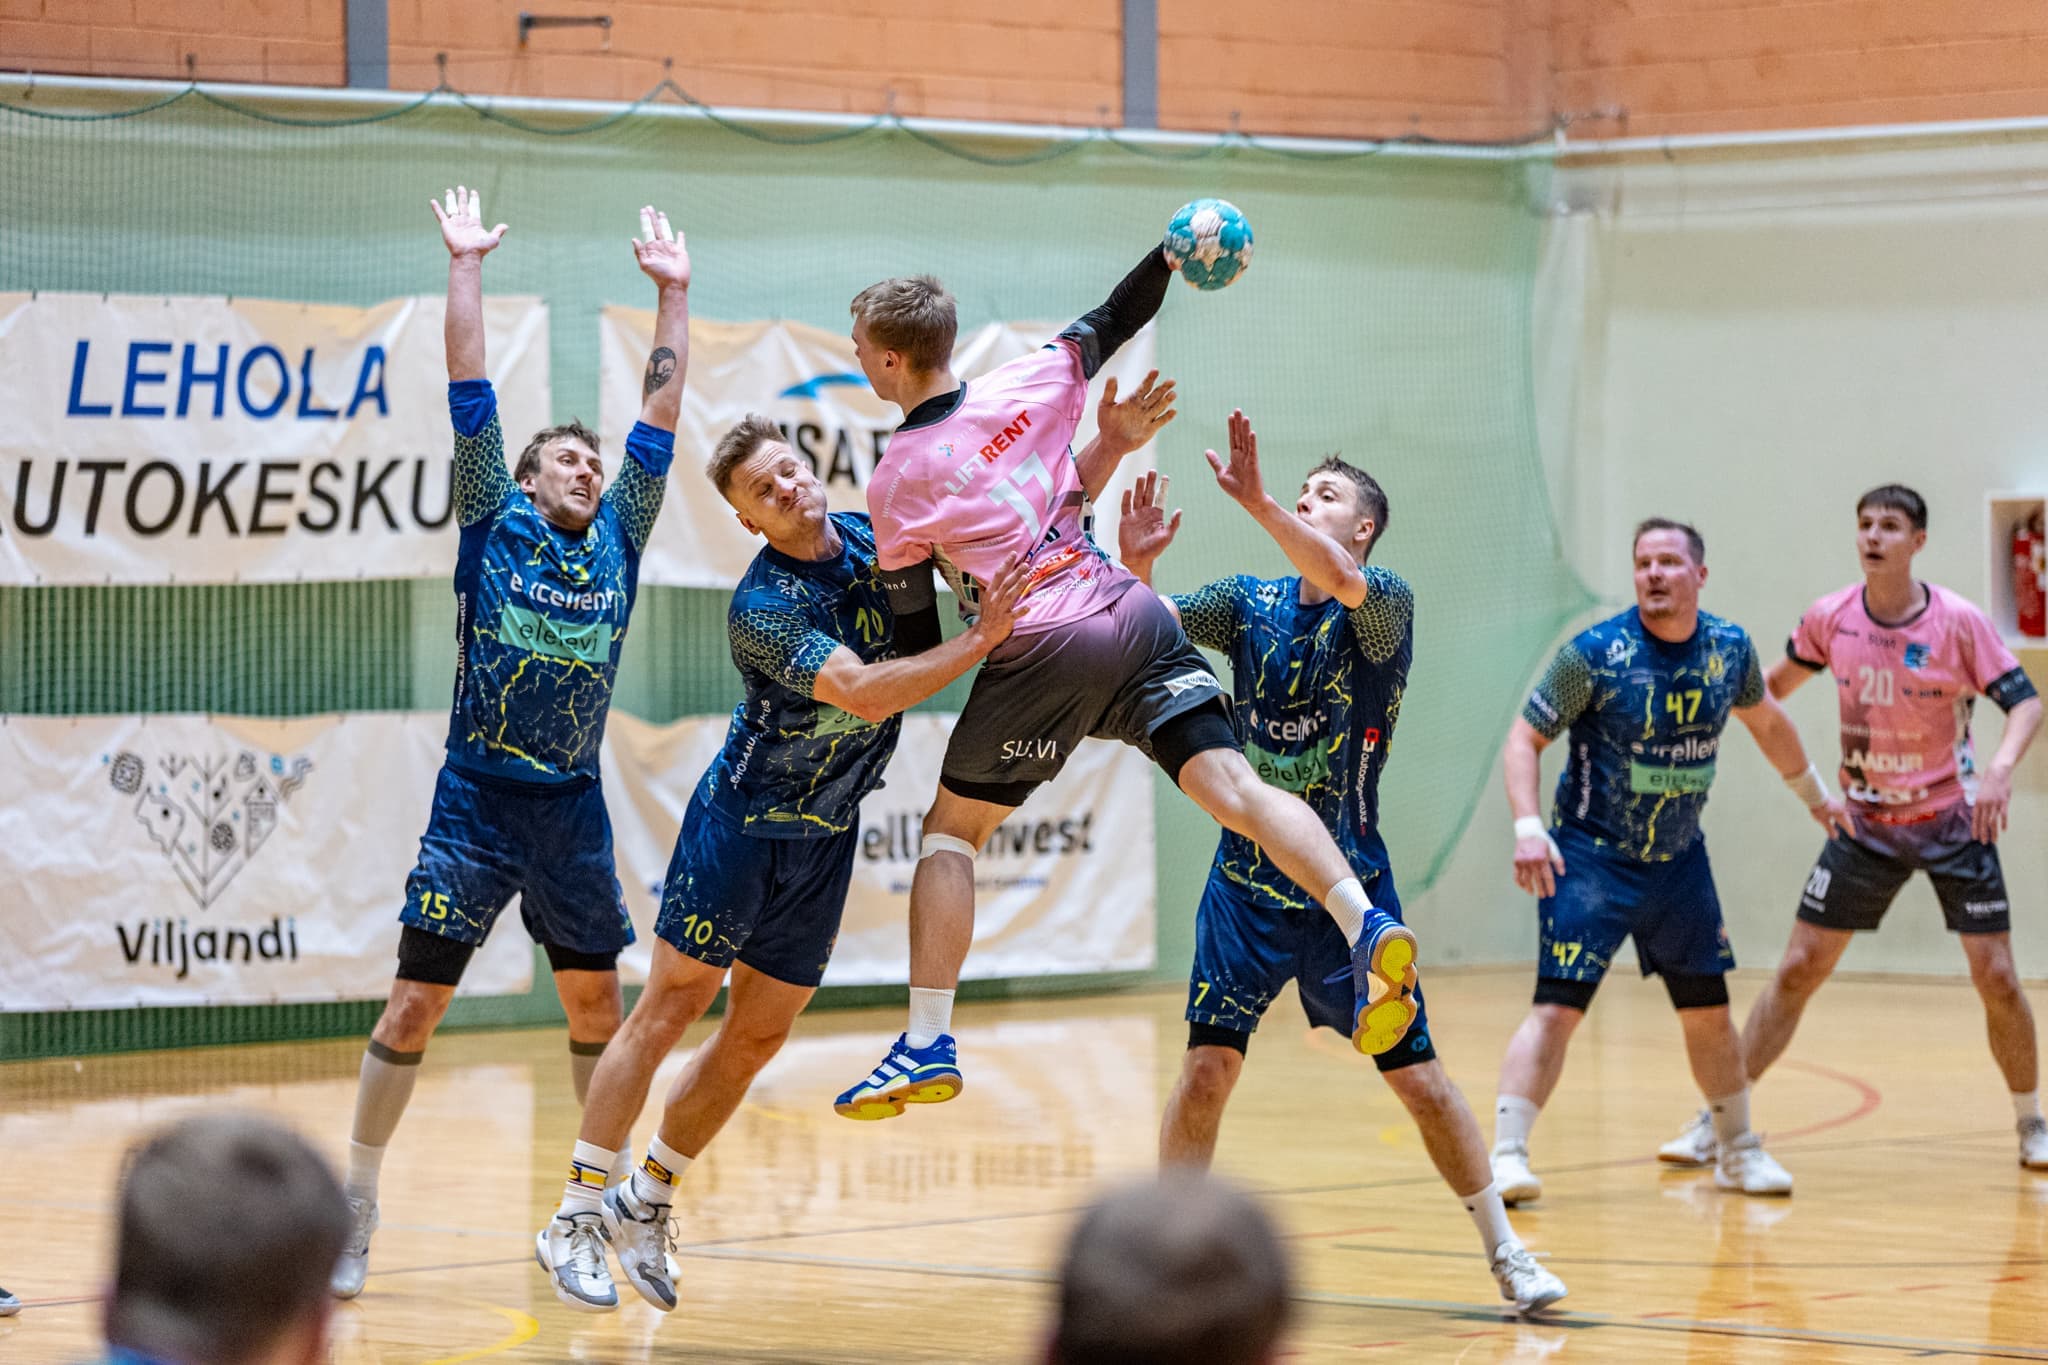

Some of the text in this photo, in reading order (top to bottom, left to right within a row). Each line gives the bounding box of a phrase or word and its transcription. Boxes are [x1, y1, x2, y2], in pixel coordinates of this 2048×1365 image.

[66, 340, 390, 418] LEHOLA
[0, 460, 457, 536] UTOKESKU
[987, 450, 1053, 540] 17
[856, 608, 885, 643] 10
[1287, 660, 1303, 697] 7
[1859, 665, 1894, 707] 20
[1666, 690, 1703, 724] 47
[1807, 866, 1831, 899] 20
[420, 890, 449, 921] 15
[683, 913, 713, 945] 10
[116, 915, 299, 981] Viljandi
[1553, 943, 1582, 966] 47
[1194, 982, 1211, 1008] 7
